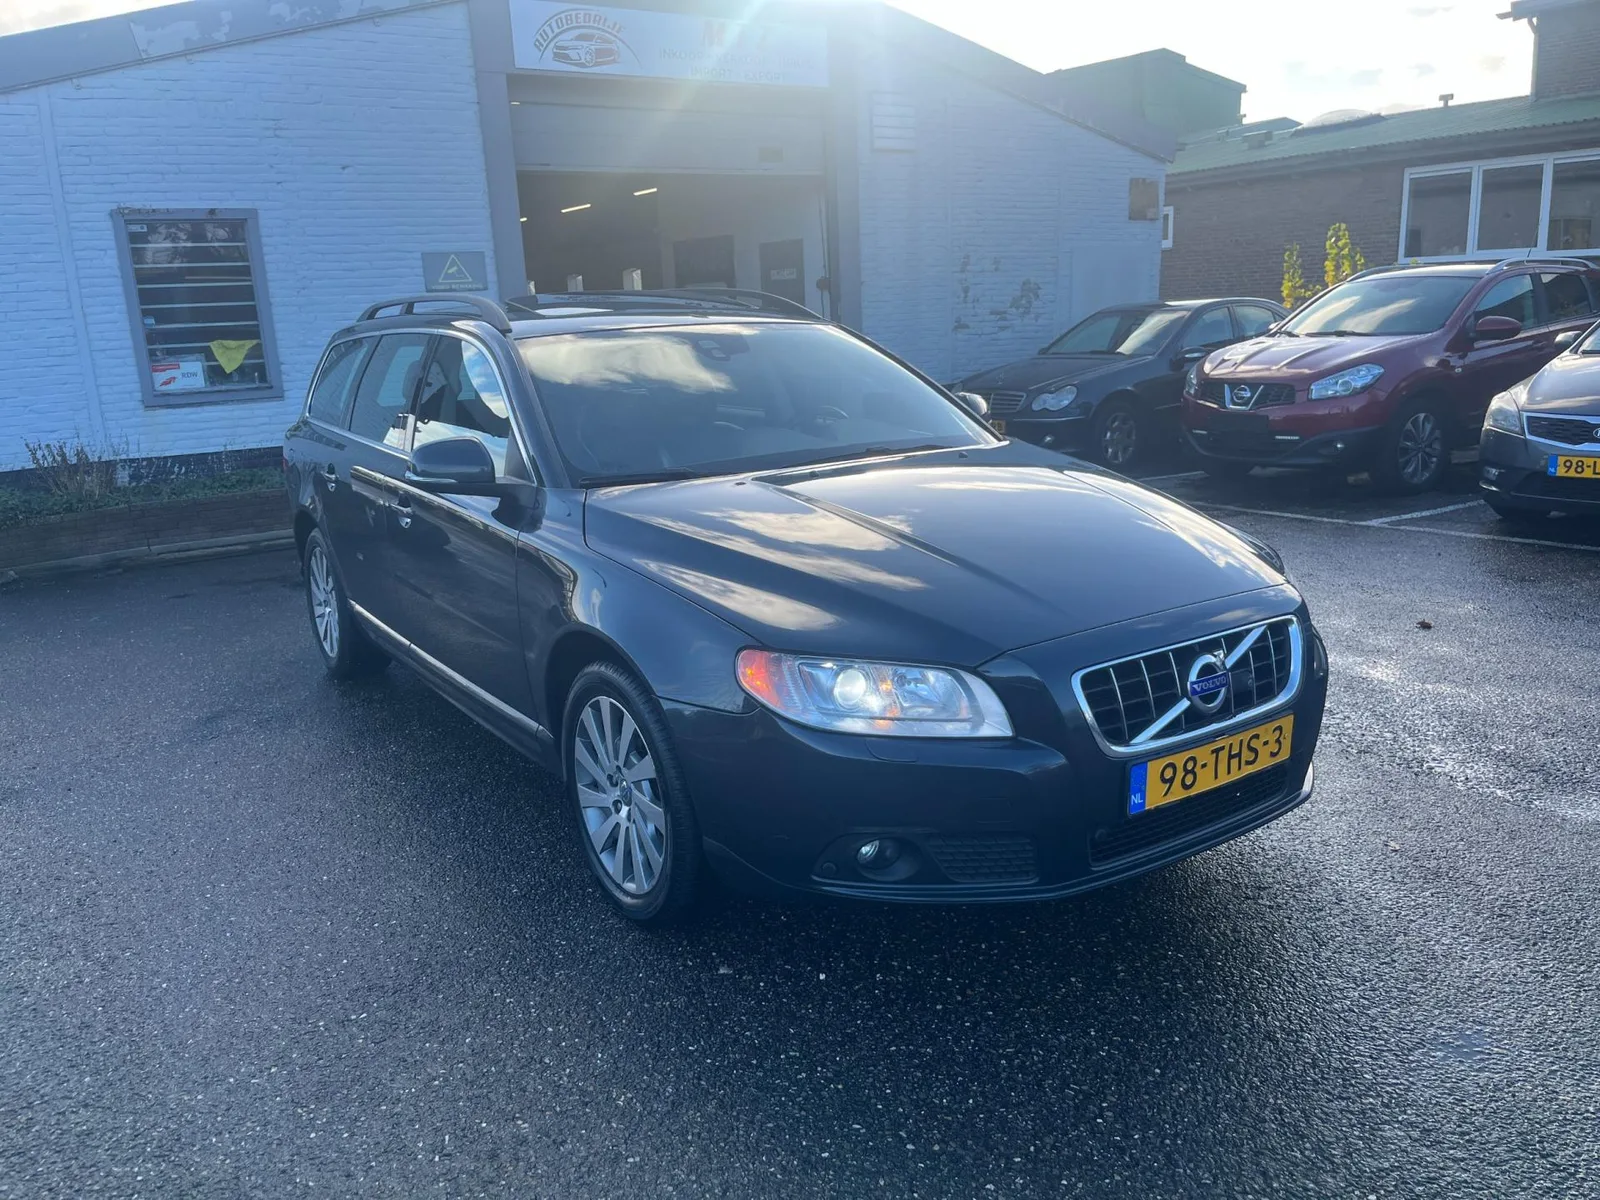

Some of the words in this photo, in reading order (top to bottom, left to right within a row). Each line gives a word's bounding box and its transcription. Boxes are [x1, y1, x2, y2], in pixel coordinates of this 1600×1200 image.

[533, 12, 627, 52] AUTOBEDRIJF
[181, 371, 198, 379] RDW
[1563, 459, 1600, 475] 98-L
[1192, 675, 1227, 692] VOLVO
[1131, 793, 1144, 805] NL
[1159, 724, 1284, 797] 98-THS-3
